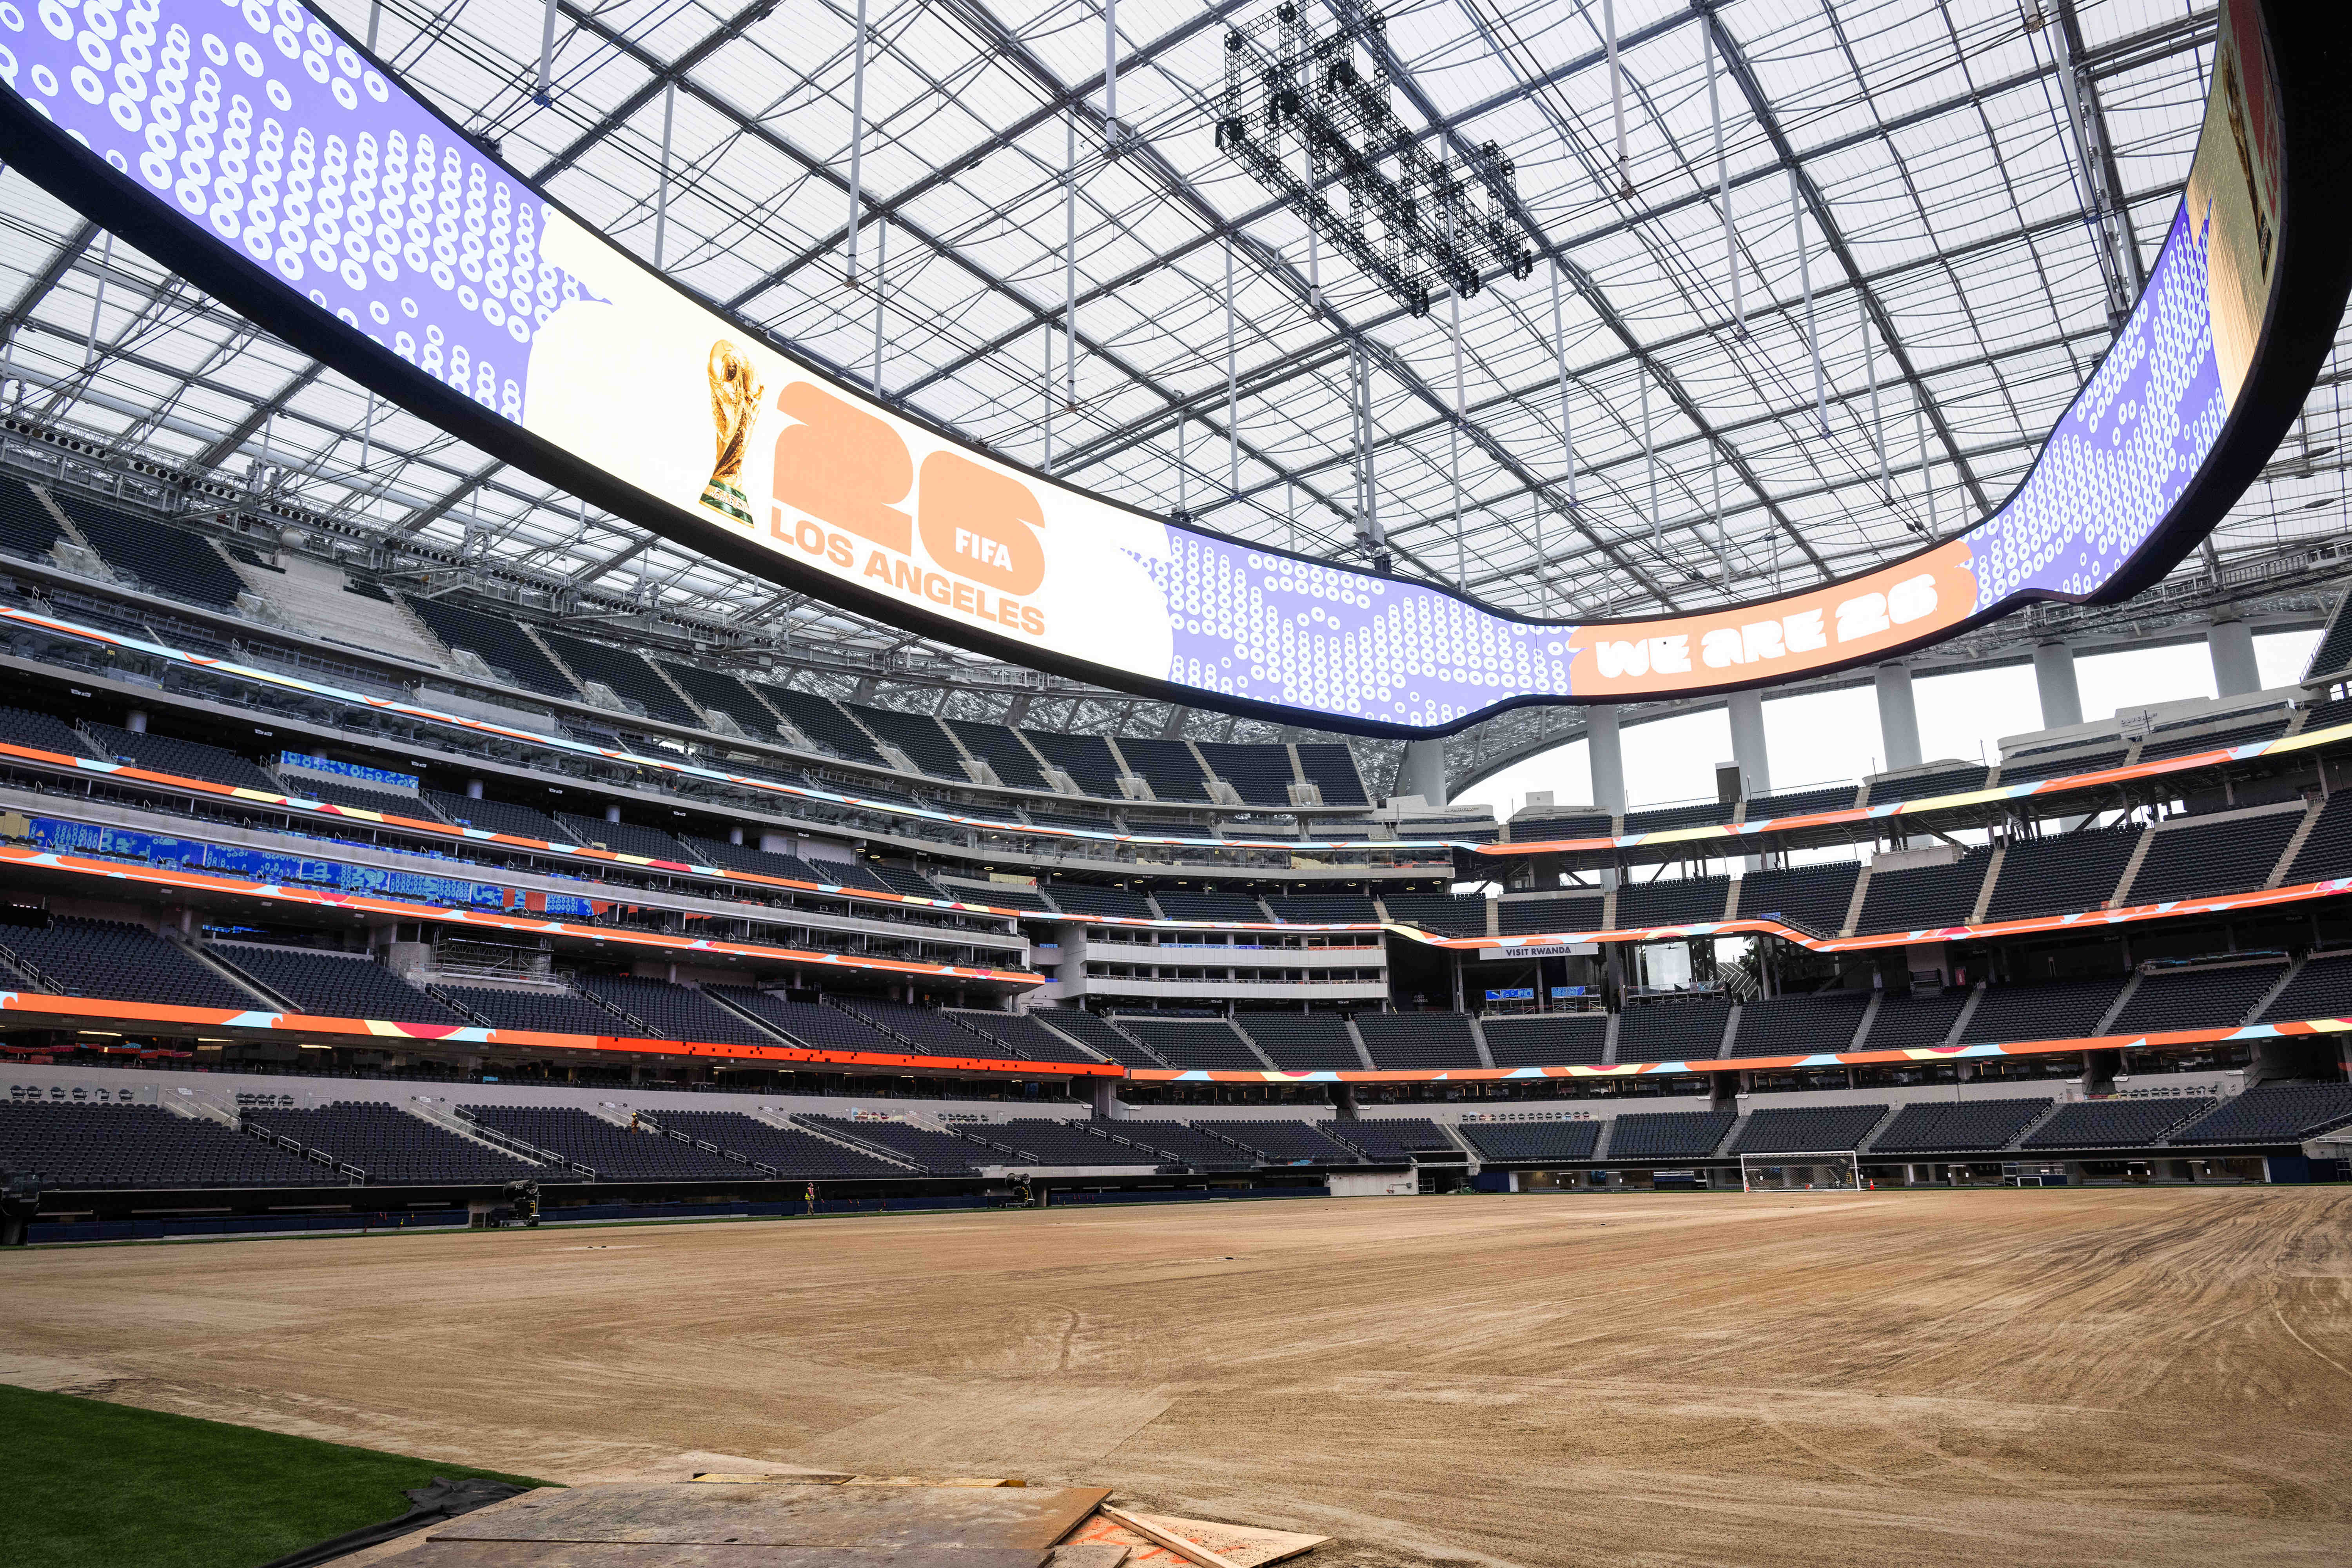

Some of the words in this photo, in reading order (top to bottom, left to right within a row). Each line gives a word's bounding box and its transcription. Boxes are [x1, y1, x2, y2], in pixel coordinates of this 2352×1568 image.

[773, 381, 1045, 596] 26
[771, 506, 854, 568] LOS
[864, 552, 1045, 636] ANGELES
[955, 528, 1013, 573] FIFA
[1596, 634, 1691, 677] WE
[1702, 608, 1827, 668] ARE
[1835, 573, 1938, 643] 26
[1531, 946, 1572, 955] RWANDA
